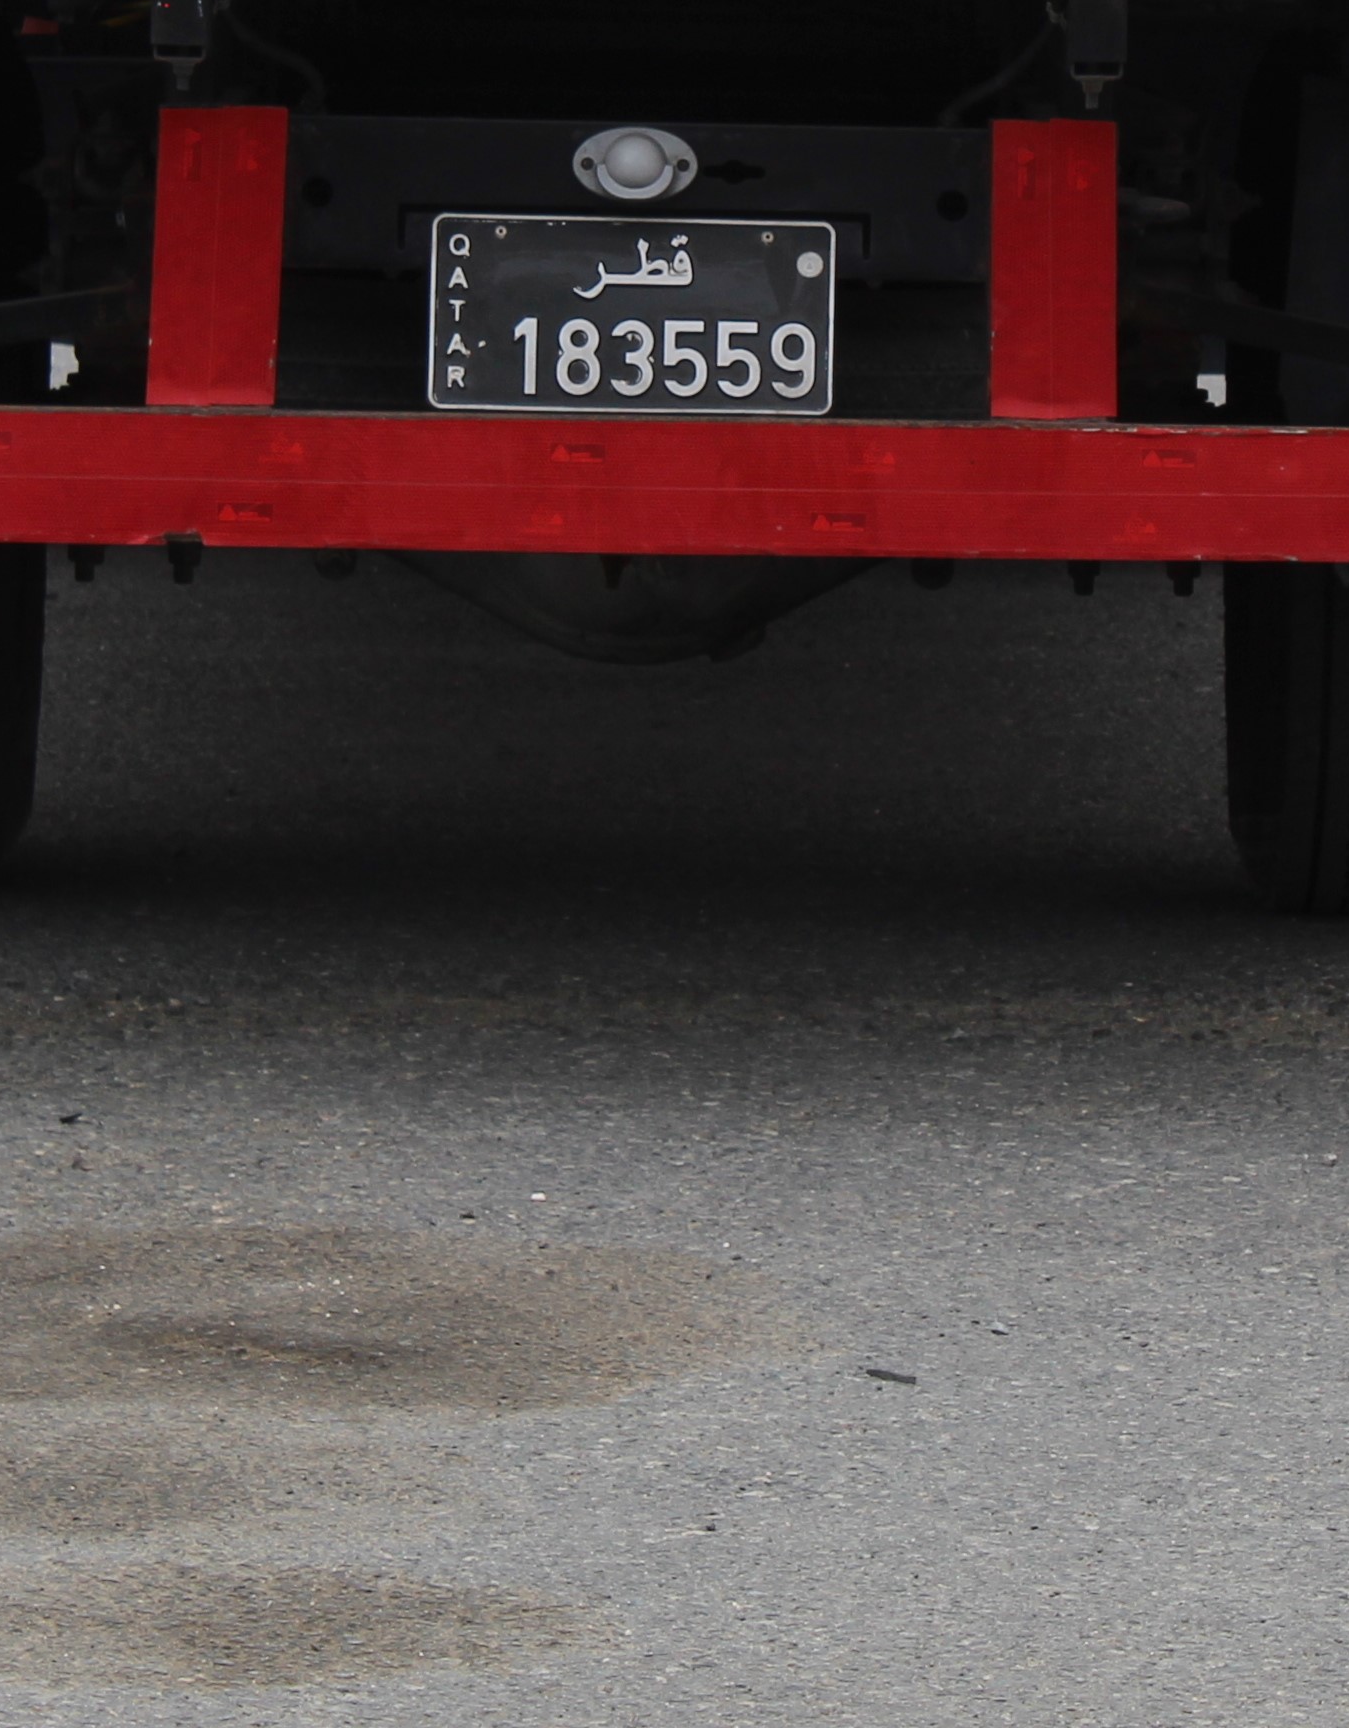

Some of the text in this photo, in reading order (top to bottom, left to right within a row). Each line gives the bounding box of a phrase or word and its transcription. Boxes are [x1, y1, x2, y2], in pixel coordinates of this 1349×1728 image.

[572, 234, 694, 299] قطر
[447, 233, 471, 388] QATAR
[513, 317, 816, 399] 183559
